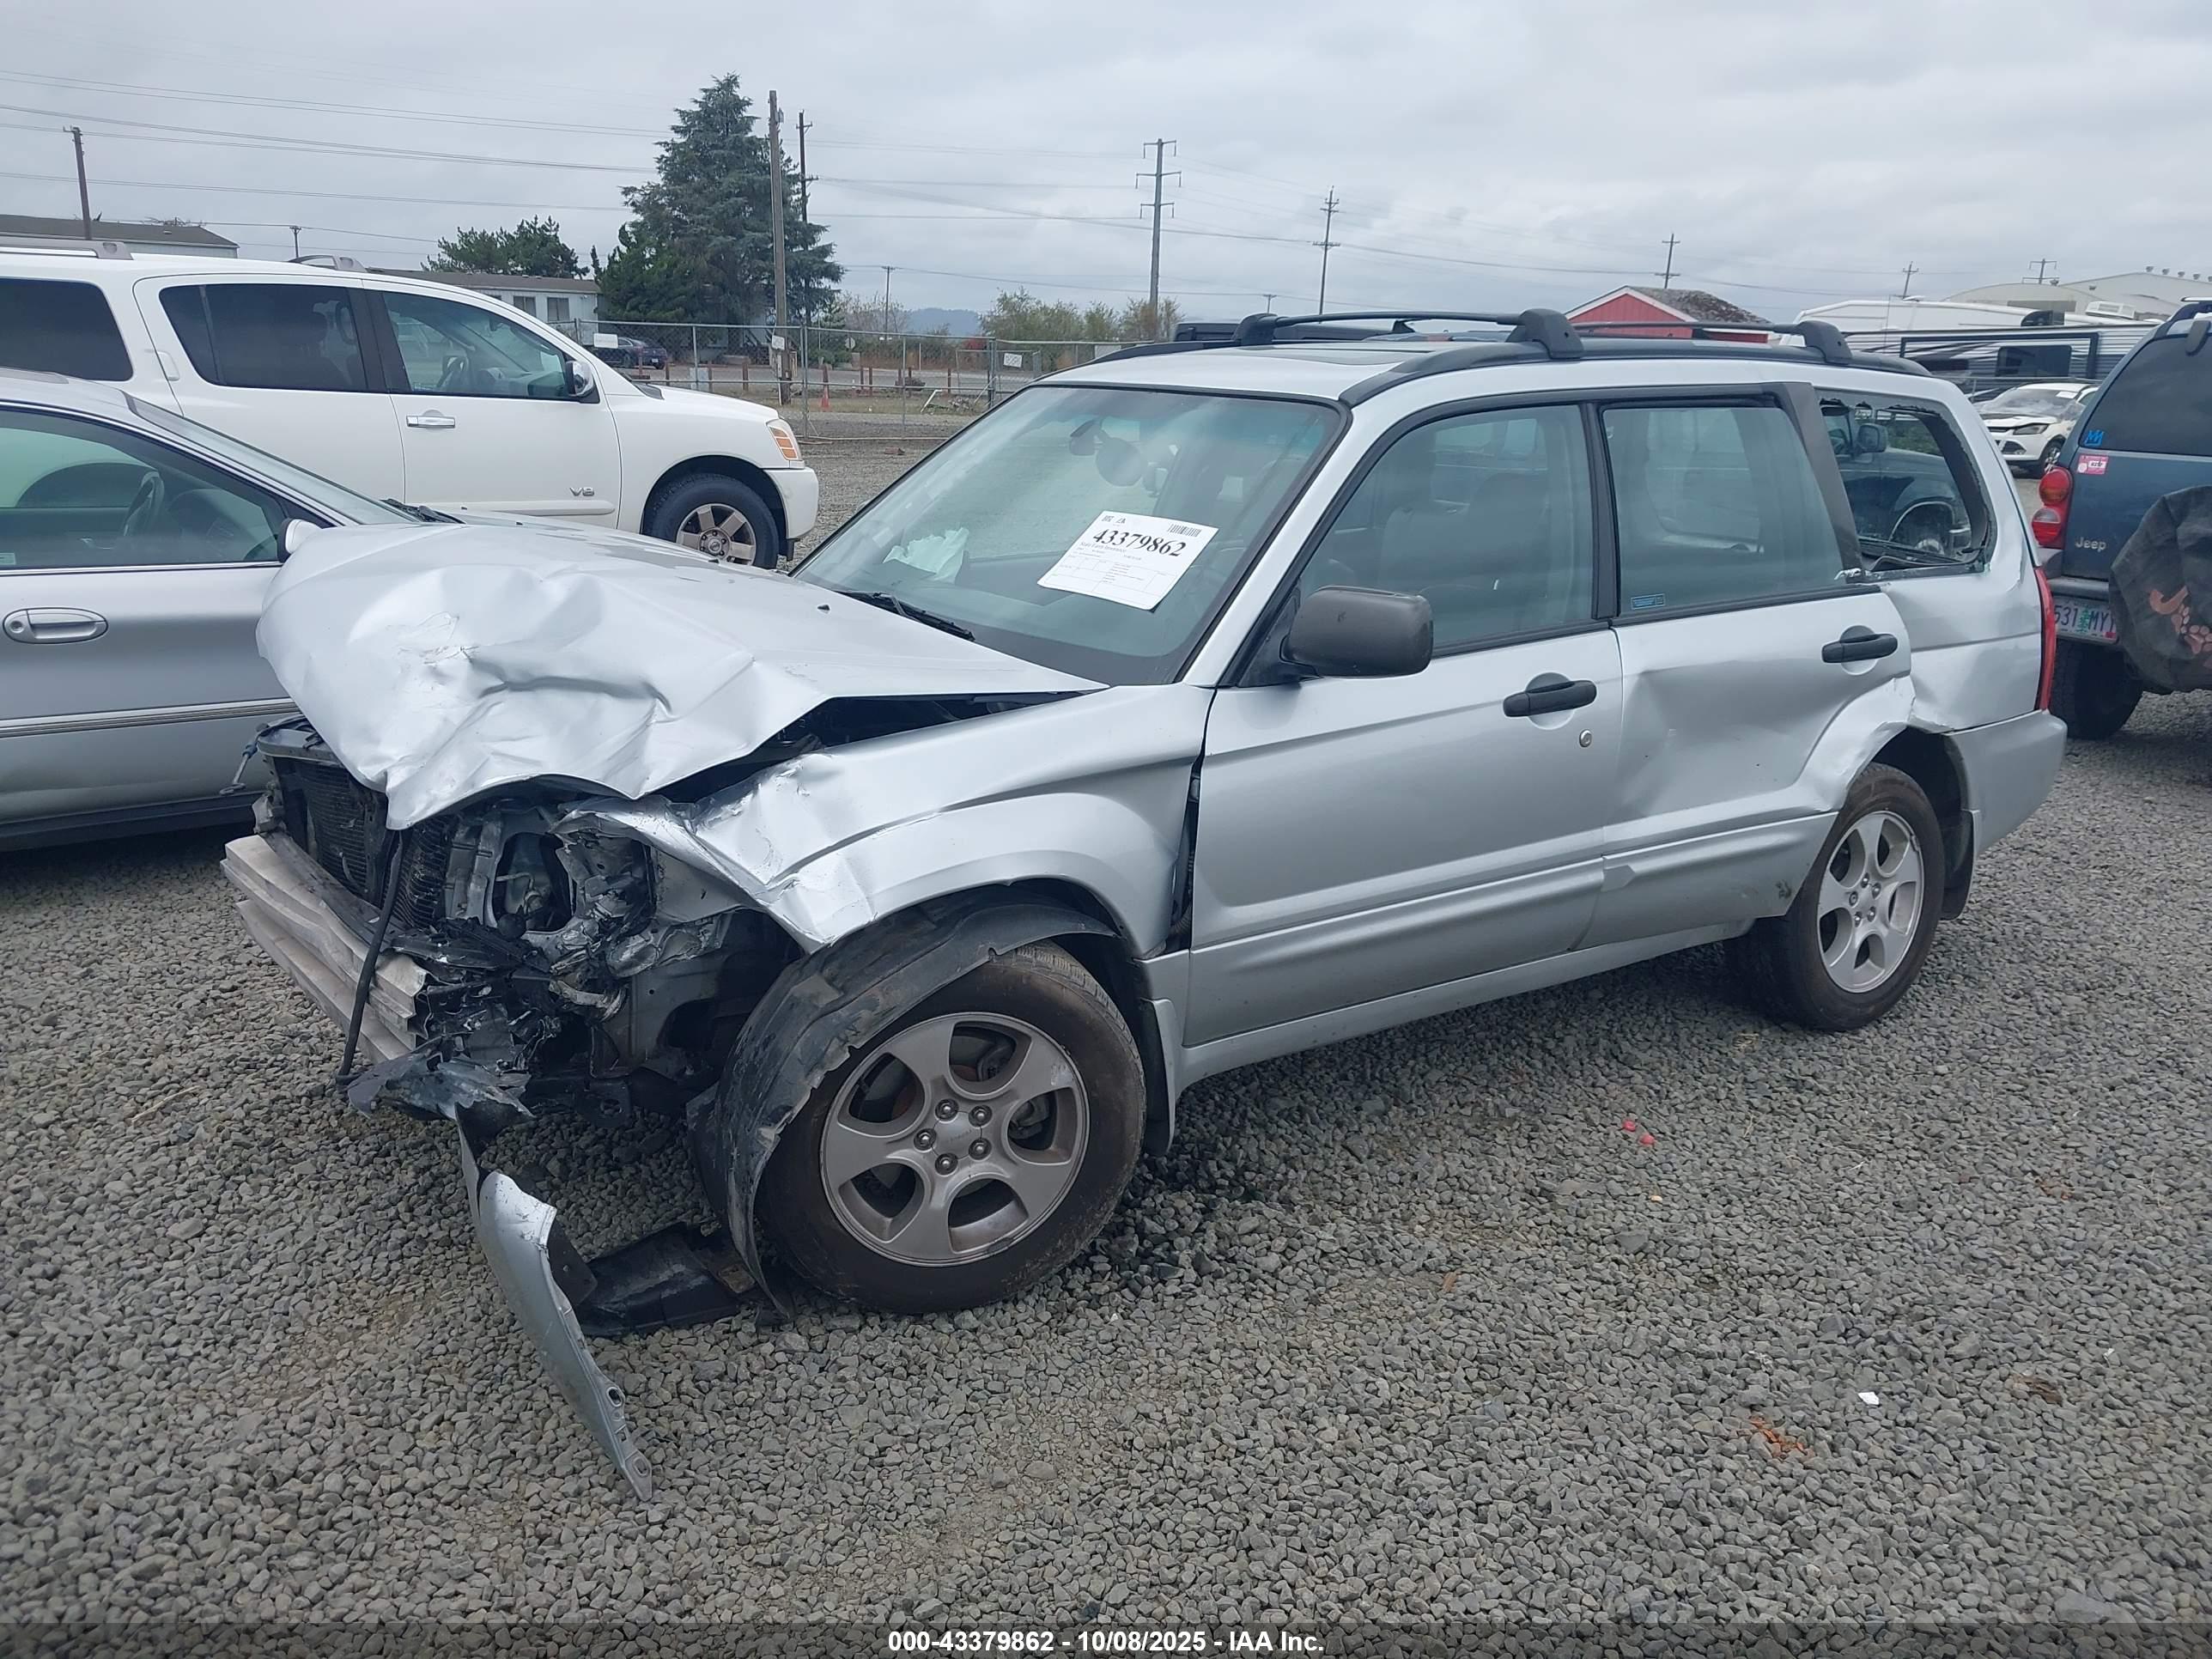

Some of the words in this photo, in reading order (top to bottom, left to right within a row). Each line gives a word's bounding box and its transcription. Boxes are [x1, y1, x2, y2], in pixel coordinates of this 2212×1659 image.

[569, 487, 594, 496] V8
[1092, 528, 1187, 557] 43379862
[2075, 536, 2106, 552] Jeep
